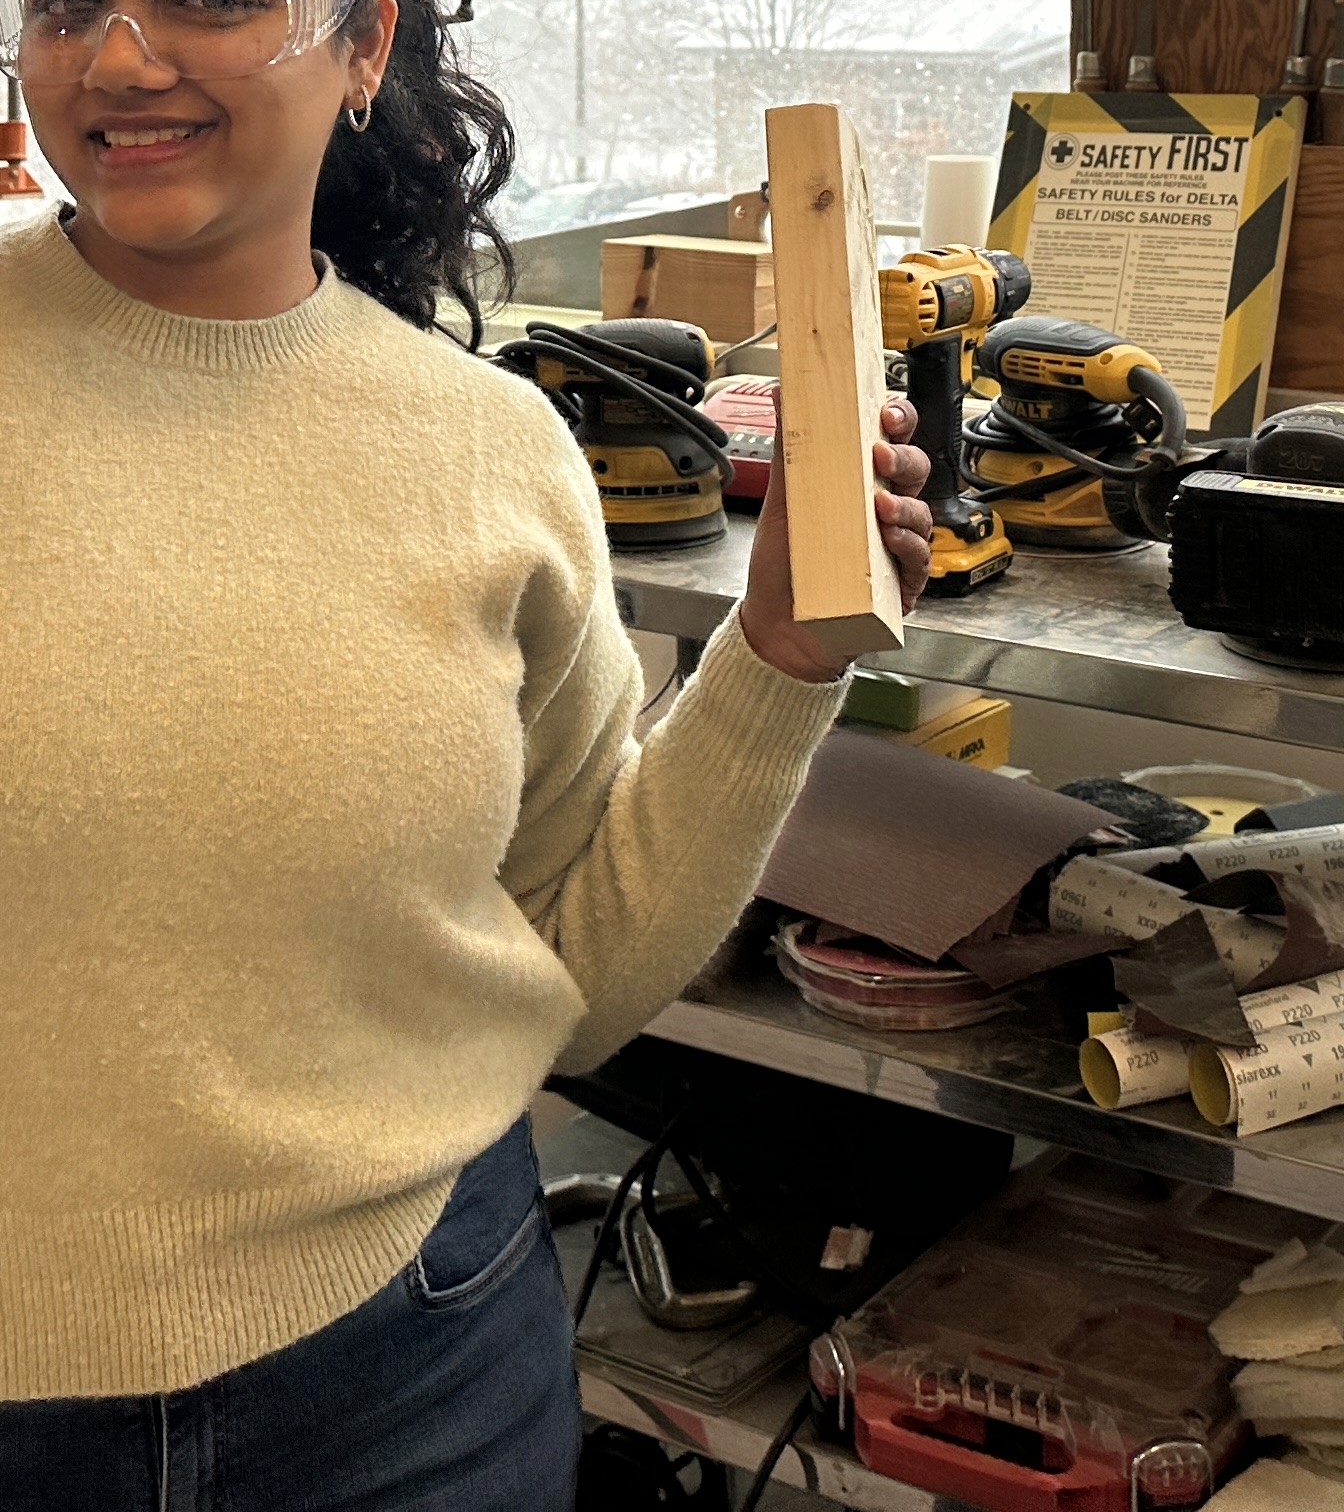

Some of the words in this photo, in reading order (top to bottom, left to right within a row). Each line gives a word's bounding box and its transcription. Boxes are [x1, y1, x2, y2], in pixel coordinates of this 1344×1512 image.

[1080, 144, 1163, 170] SAFETY
[1166, 135, 1249, 173] FIRST
[1163, 181, 1208, 189] REFERENCE
[1037, 187, 1098, 201] SAFETY
[1102, 189, 1156, 203] RULES
[1160, 191, 1182, 204] for
[1186, 192, 1239, 206] DELTA
[1139, 211, 1212, 226] SANDERS
[1215, 854, 1247, 870] P220
[1268, 846, 1300, 861] P220
[1282, 1004, 1313, 1023] P220
[1288, 1029, 1321, 1047] P220
[1126, 1050, 1159, 1071] P220
